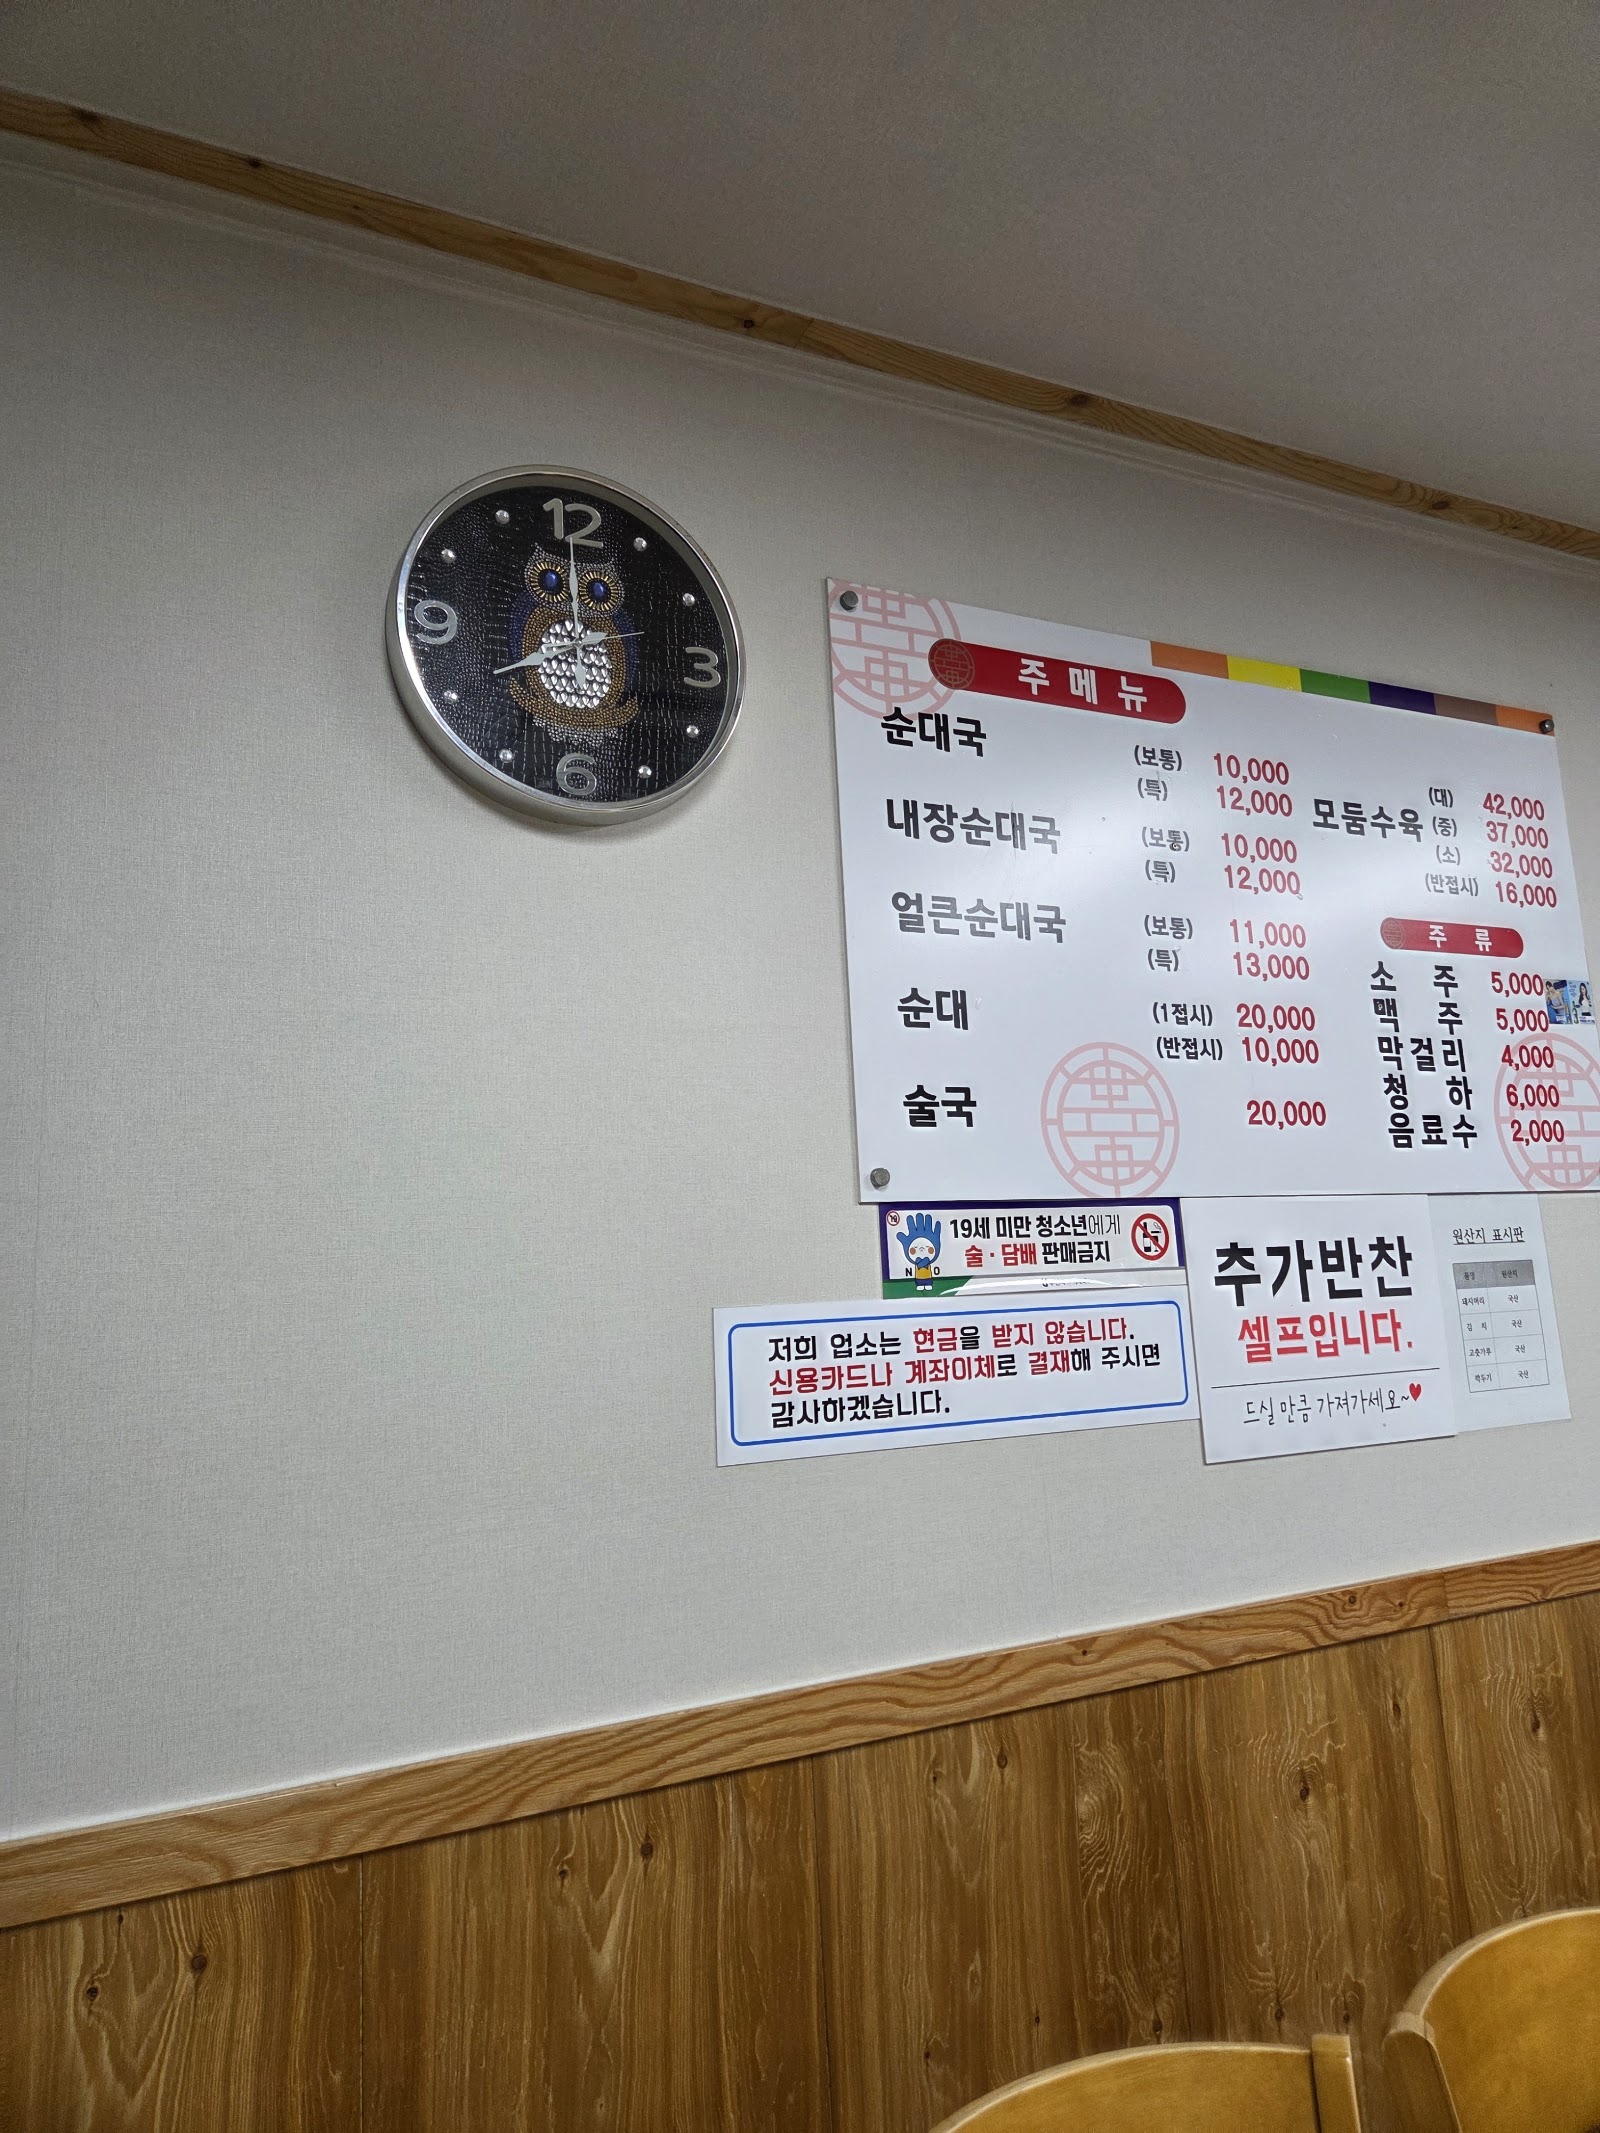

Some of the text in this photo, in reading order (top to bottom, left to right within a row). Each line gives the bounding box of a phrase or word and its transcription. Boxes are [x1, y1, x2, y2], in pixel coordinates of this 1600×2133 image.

[543, 498, 603, 548] 12
[413, 600, 457, 644] 9
[683, 647, 721, 688] 3
[881, 707, 1290, 785] 순대국 (보통) 10,000
[556, 754, 595, 796] 6
[1137, 778, 1293, 817] (특) 12,000
[1428, 786, 1544, 821] (대) 42,000
[886, 799, 1297, 864] 내장순대국 (보통) 10,000
[1312, 798, 1424, 842] 모둠수육
[1432, 816, 1549, 850] (중) 37,000
[1145, 860, 1300, 896] (특) 12,000
[1435, 845, 1553, 879] (소) 32,000
[1424, 872, 1557, 909] (반접시) 16,000
[892, 891, 1307, 950] 얼큰순대국 (보통) 11,000
[1147, 948, 1310, 982] (특) 13,000
[1491, 971, 1544, 998] 5,000
[897, 987, 1316, 1033] 순대 (1접시) 20,000
[1496, 1008, 1549, 1034] 5,000
[1156, 1036, 1319, 1066] (반접시) 10,000
[1501, 1045, 1555, 1071] 4,000
[902, 1084, 1326, 1130] 술국 20,000
[1506, 1083, 1560, 1110] 6,000
[1510, 1119, 1564, 1146] 2,000
[950, 1214, 1121, 1240] 19세 미만 청소년에게
[1452, 1226, 1524, 1244] 원산지 표시판
[1042, 1241, 1111, 1264] 판매금지
[1214, 1235, 1412, 1306] 추가반찬
[1508, 1294, 1519, 1303] 국산
[769, 1318, 1135, 1362] 저희 업소는 현금을 받지 않습니다.
[1238, 1308, 1412, 1363] 셀프입니다.
[1511, 1319, 1522, 1328] 국산
[1515, 1344, 1526, 1353] 국산
[769, 1343, 1160, 1396] 신용카드나 계좌이체로 결재해 주시면
[1518, 1370, 1529, 1379] 국산
[771, 1389, 950, 1428] 감사하겠습니다.
[1244, 1397, 1274, 1425] 드실
[1281, 1394, 1311, 1423] 만큼
